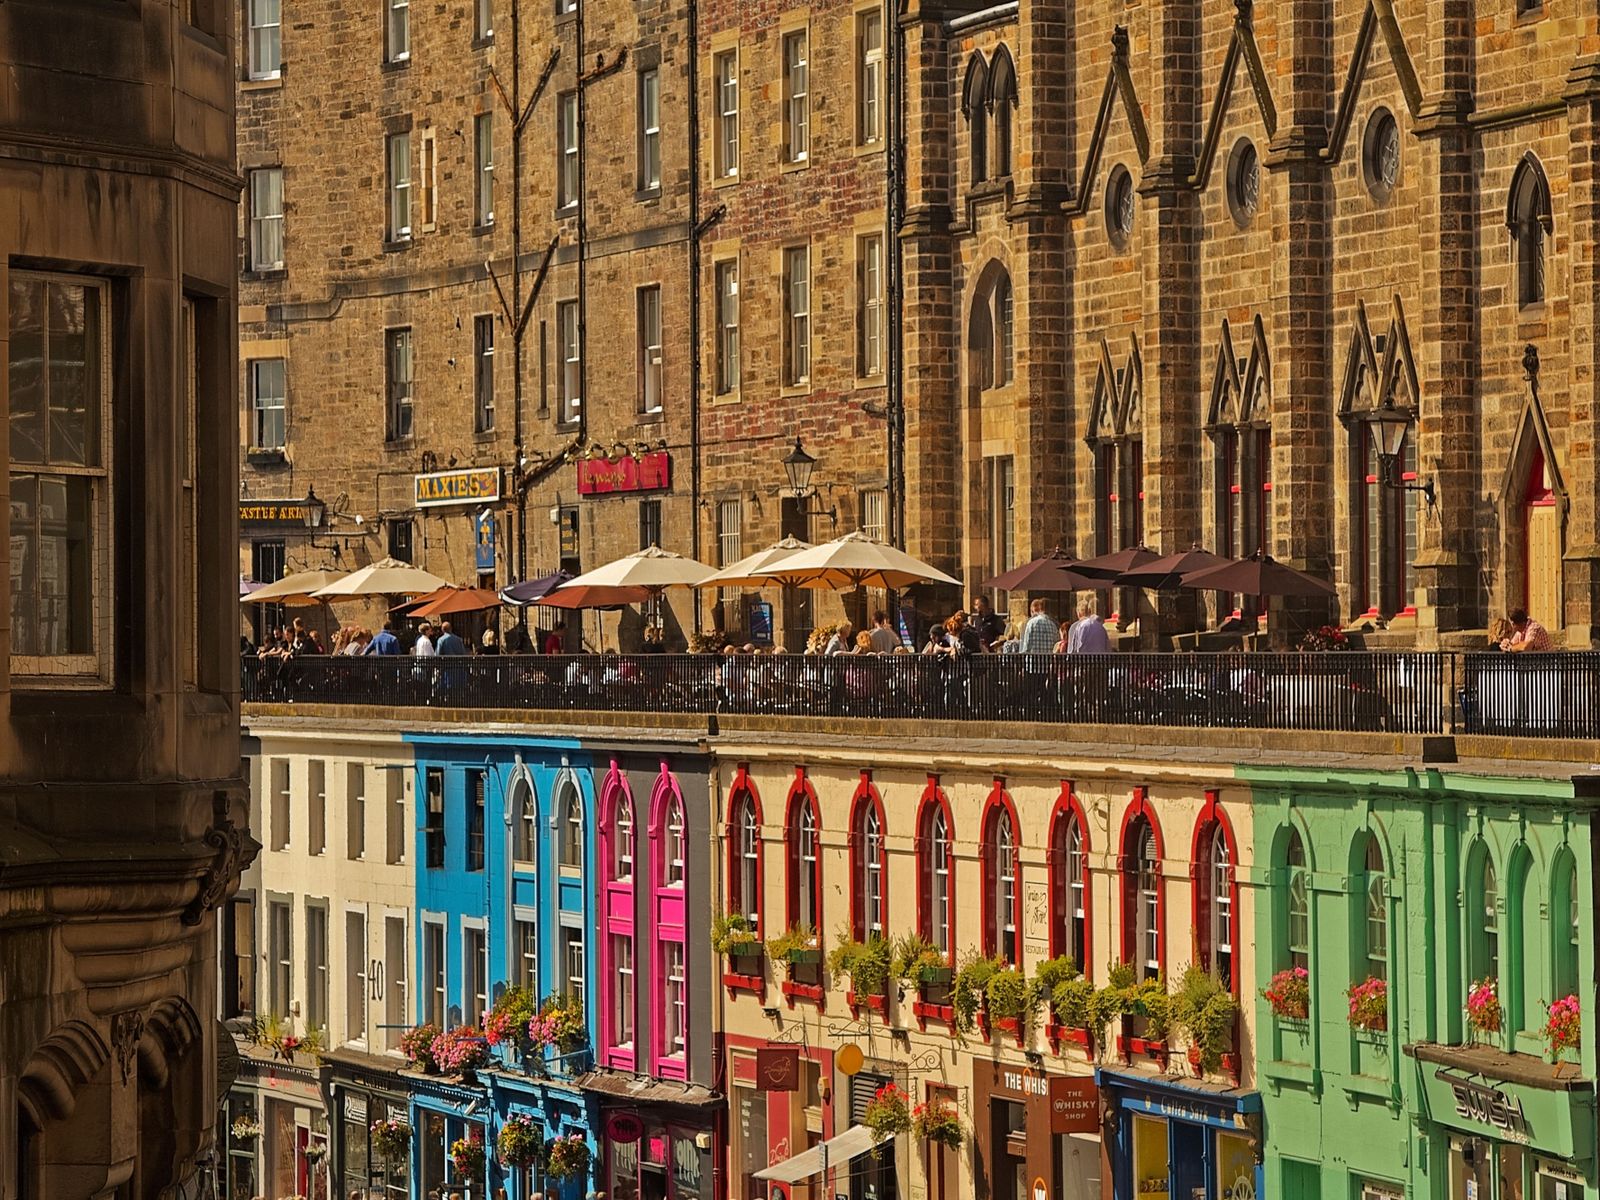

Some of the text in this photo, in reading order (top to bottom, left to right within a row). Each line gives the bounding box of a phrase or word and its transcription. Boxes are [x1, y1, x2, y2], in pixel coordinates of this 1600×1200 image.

[418, 474, 480, 500] MAXIES
[240, 506, 275, 519] ASTLE
[368, 959, 384, 1001] 40
[1004, 1072, 1021, 1090] THE
[1055, 1100, 1096, 1110] WHISKY
[1451, 1083, 1526, 1131] SWISH
